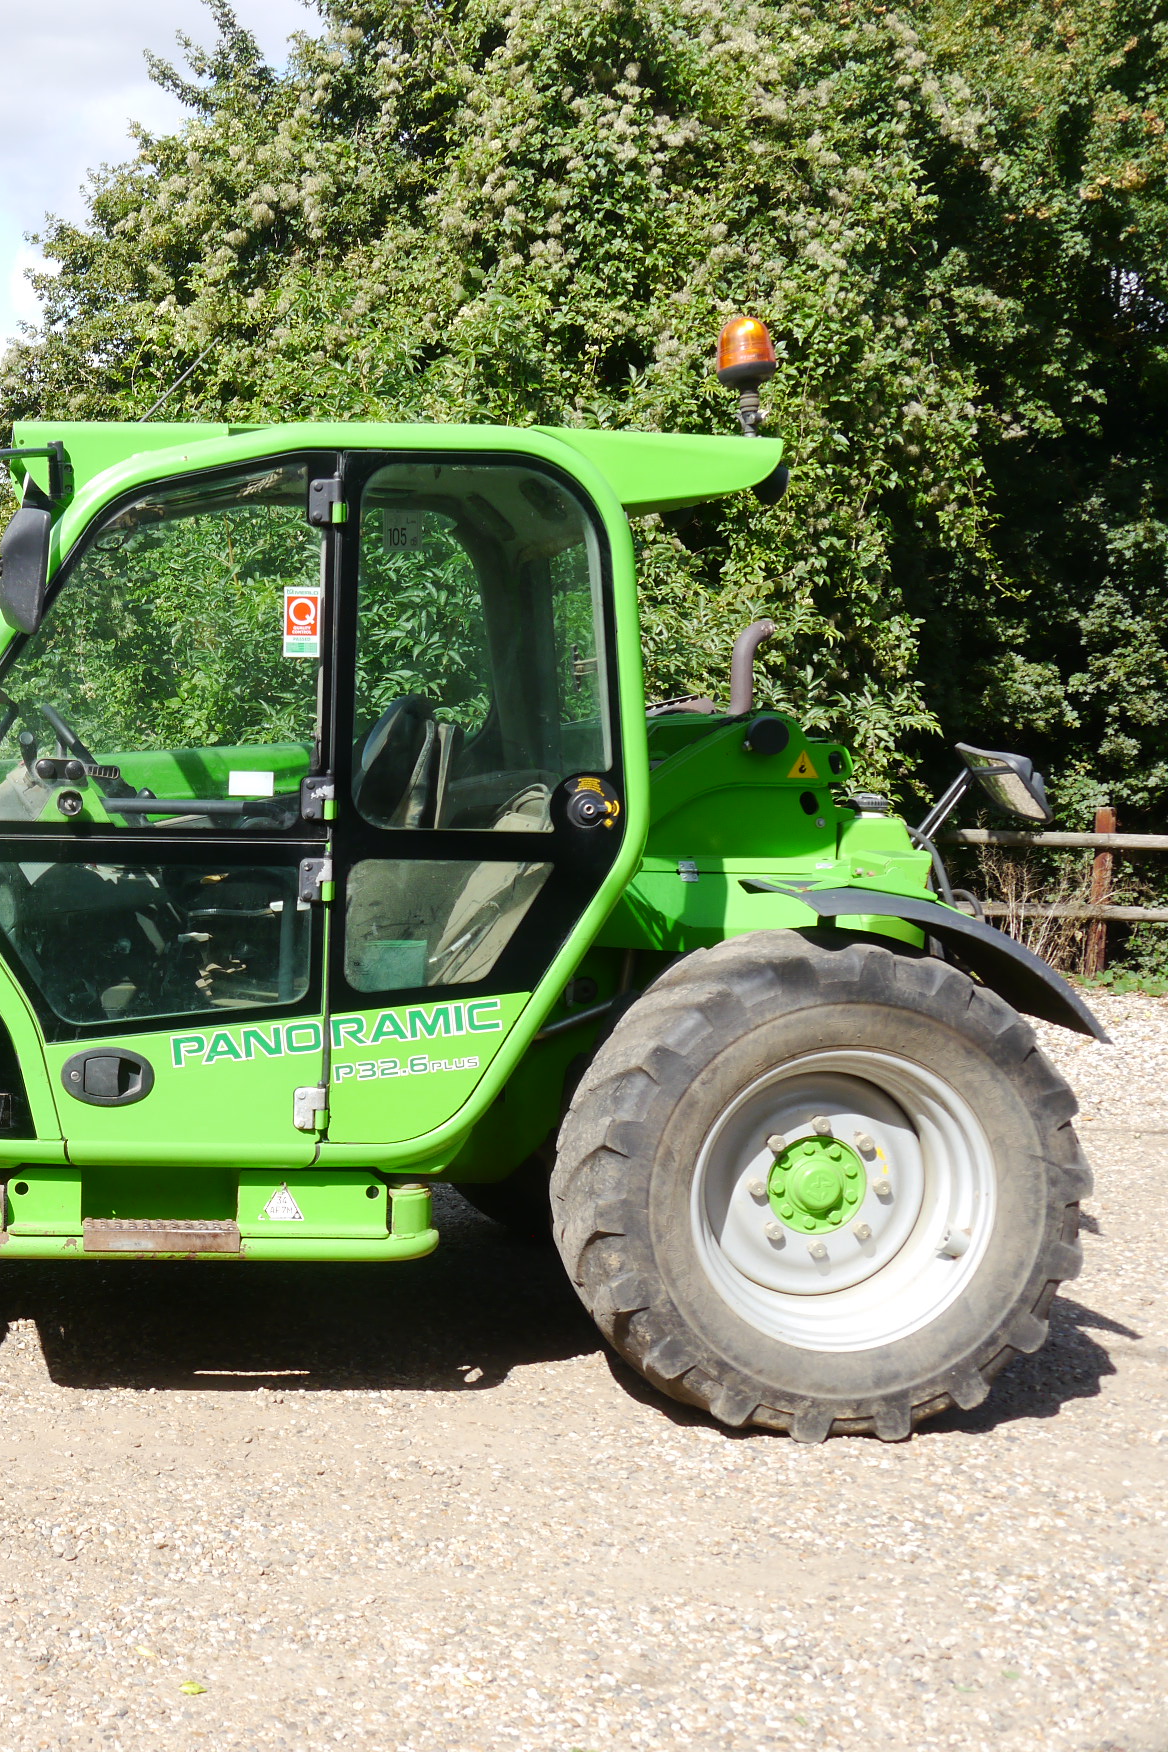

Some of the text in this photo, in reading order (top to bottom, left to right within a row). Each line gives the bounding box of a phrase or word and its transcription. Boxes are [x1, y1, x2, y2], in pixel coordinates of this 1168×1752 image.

[388, 527, 407, 547] 105
[289, 598, 316, 626] Q
[171, 999, 503, 1068] PANORAMIC
